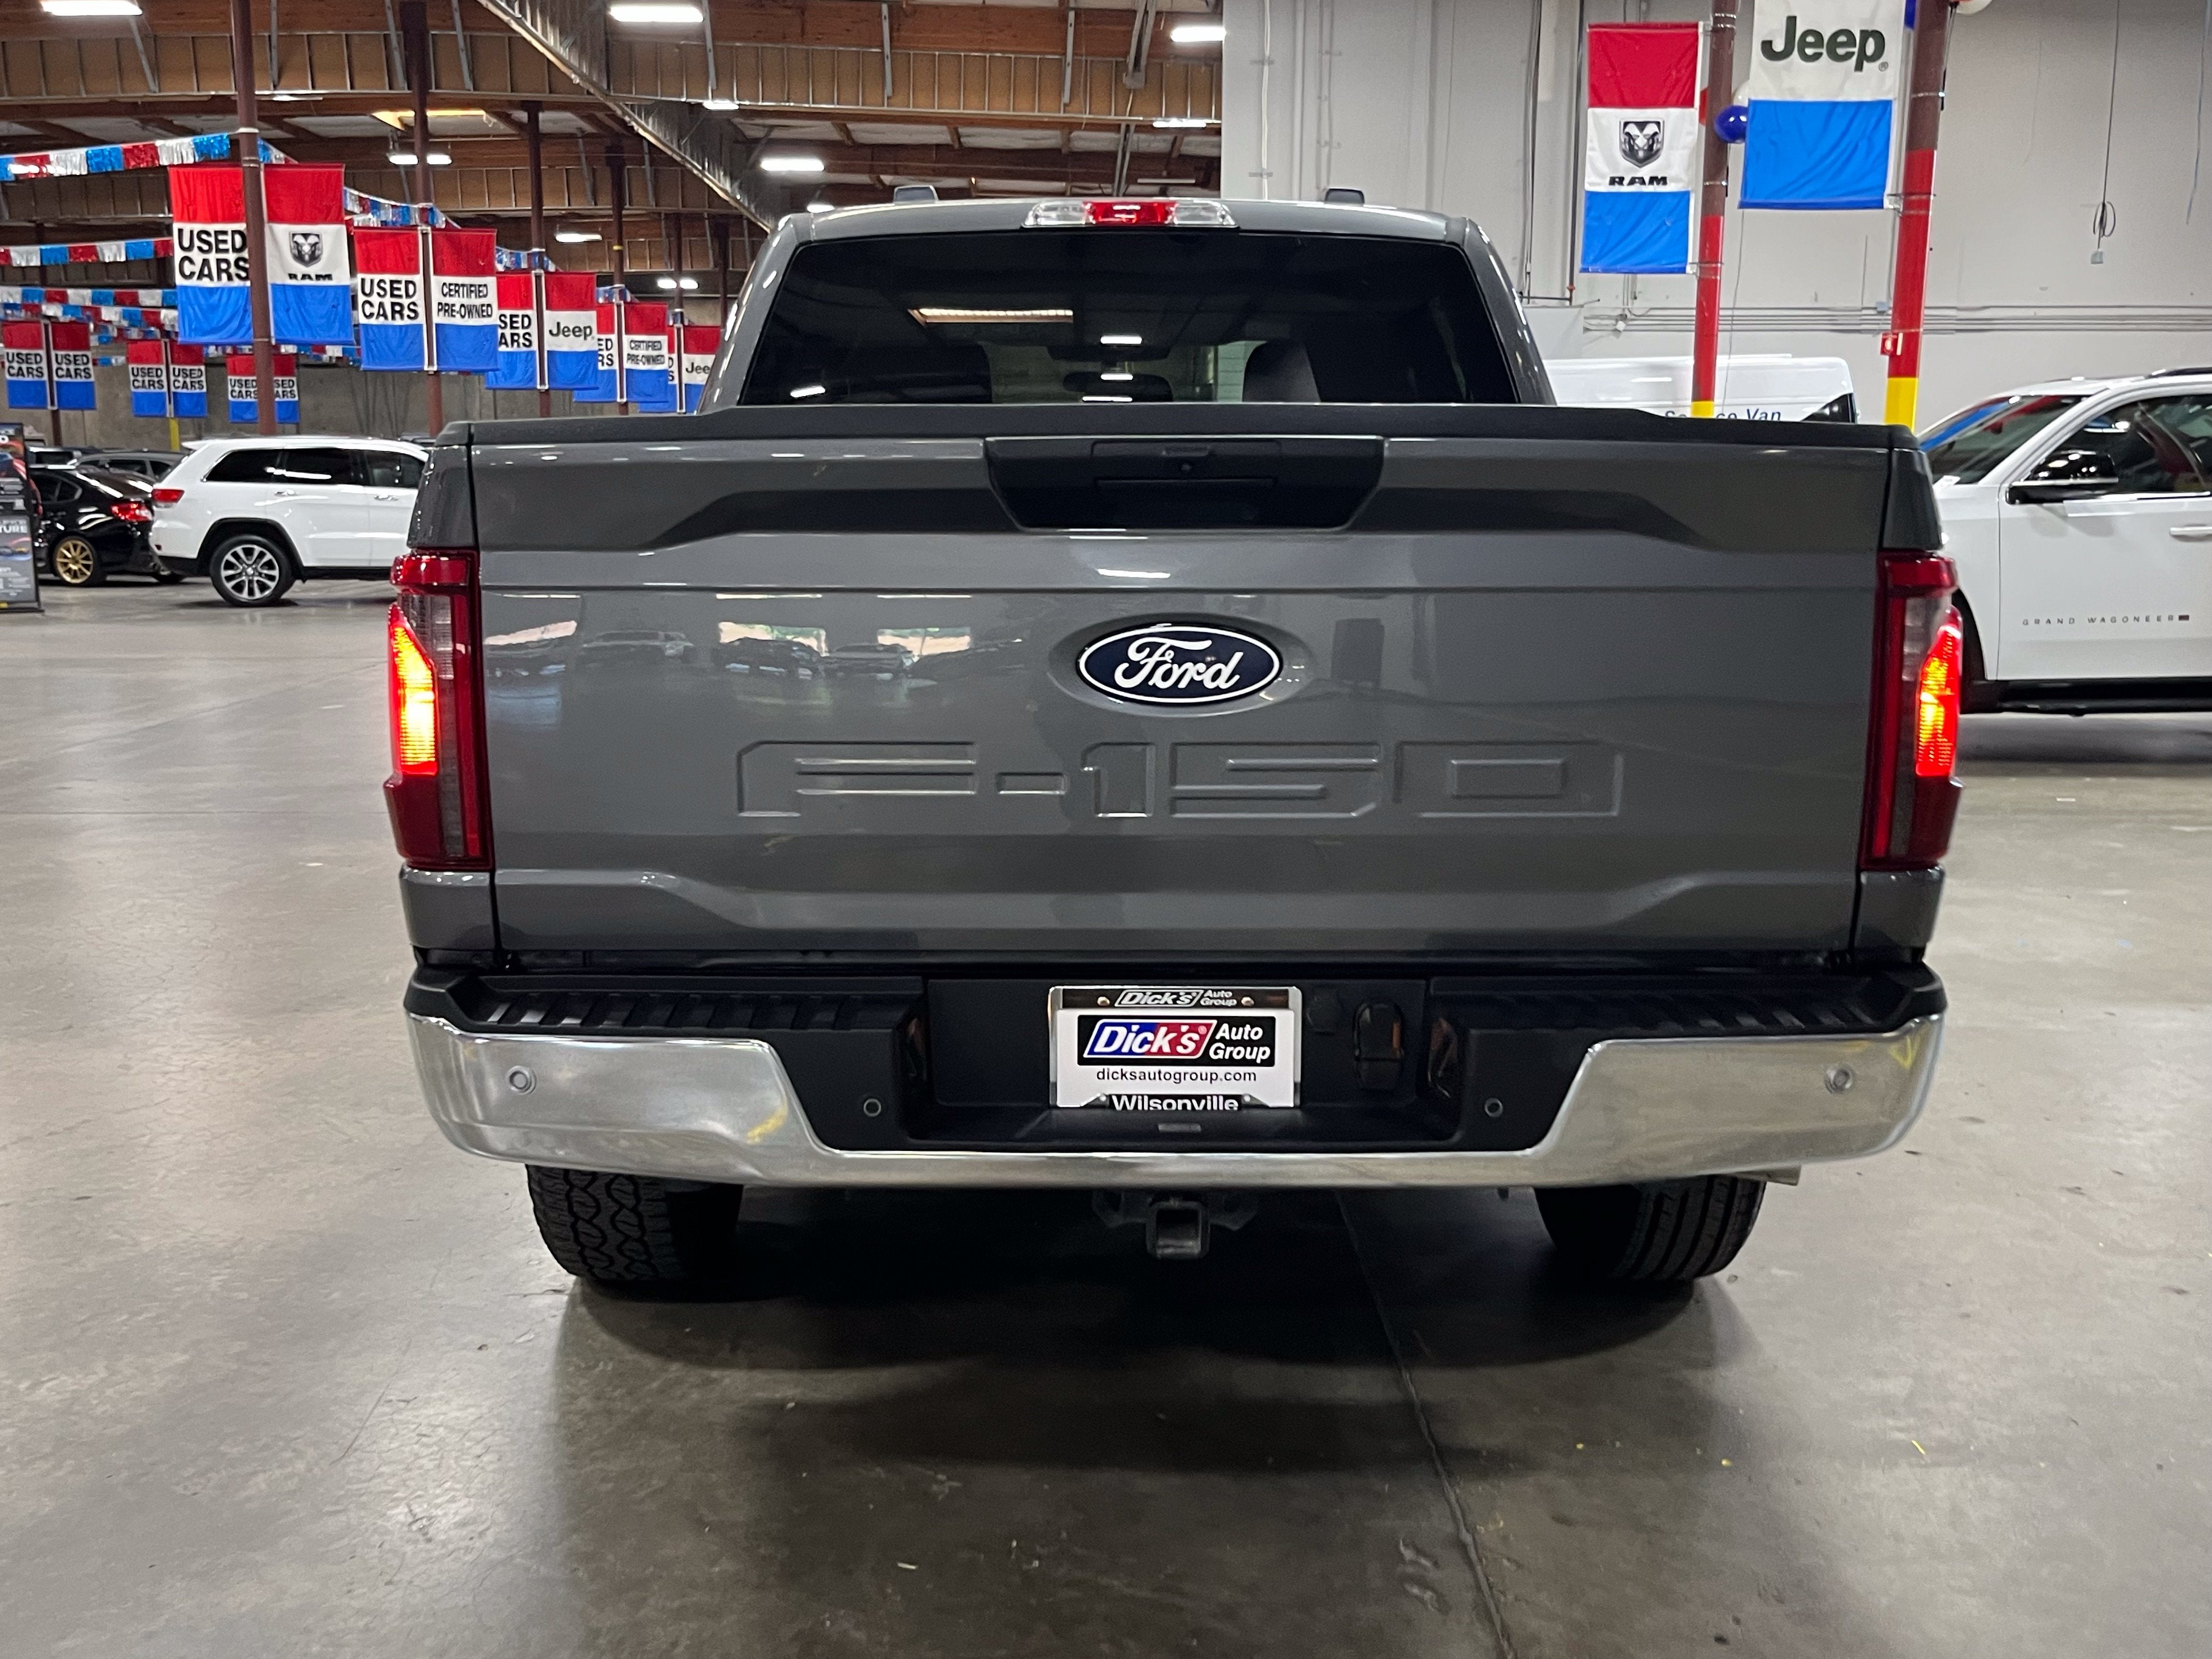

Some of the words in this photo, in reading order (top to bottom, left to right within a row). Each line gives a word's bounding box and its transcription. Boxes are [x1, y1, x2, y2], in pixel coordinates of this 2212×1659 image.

[1760, 15, 1886, 72] Jeep
[1608, 176, 1668, 187] RAM
[177, 228, 247, 254] USED
[178, 255, 250, 281] CARS
[360, 278, 417, 300] USED
[441, 282, 488, 298] CERTIFIED
[362, 300, 419, 321] CARS
[437, 302, 493, 319] PRE-OWNED
[499, 314, 532, 330] SED
[549, 321, 592, 340] Jeep
[499, 332, 533, 348] ARS
[597, 338, 613, 351] ED
[7, 352, 42, 364] USED
[55, 354, 89, 365] USED
[7, 366, 44, 378] CARS
[55, 367, 92, 379] CARS
[132, 367, 163, 378] USED
[173, 368, 203, 379] USED
[685, 362, 710, 374] Jee
[132, 379, 164, 390] CARS
[173, 379, 204, 390] CARS
[229, 379, 257, 388] USED
[274, 379, 295, 388] SED
[275, 390, 296, 399] ARS
[1746, 408, 1781, 421] Van
[2022, 617, 2075, 626] GRAND
[2087, 614, 2174, 623] WAGONEER
[1114, 636, 1244, 689] Ford
[735, 741, 1625, 817] F-150
[1120, 992, 1193, 1005] Dick's
[1200, 998, 1238, 1007] Group
[1215, 1023, 1263, 1040] Auto
[1094, 1024, 1200, 1054] Dick's
[1209, 1042, 1271, 1064] Group
[1097, 1068, 1257, 1084] dicksautogroup.com
[1111, 1094, 1239, 1111] Wilsonville
